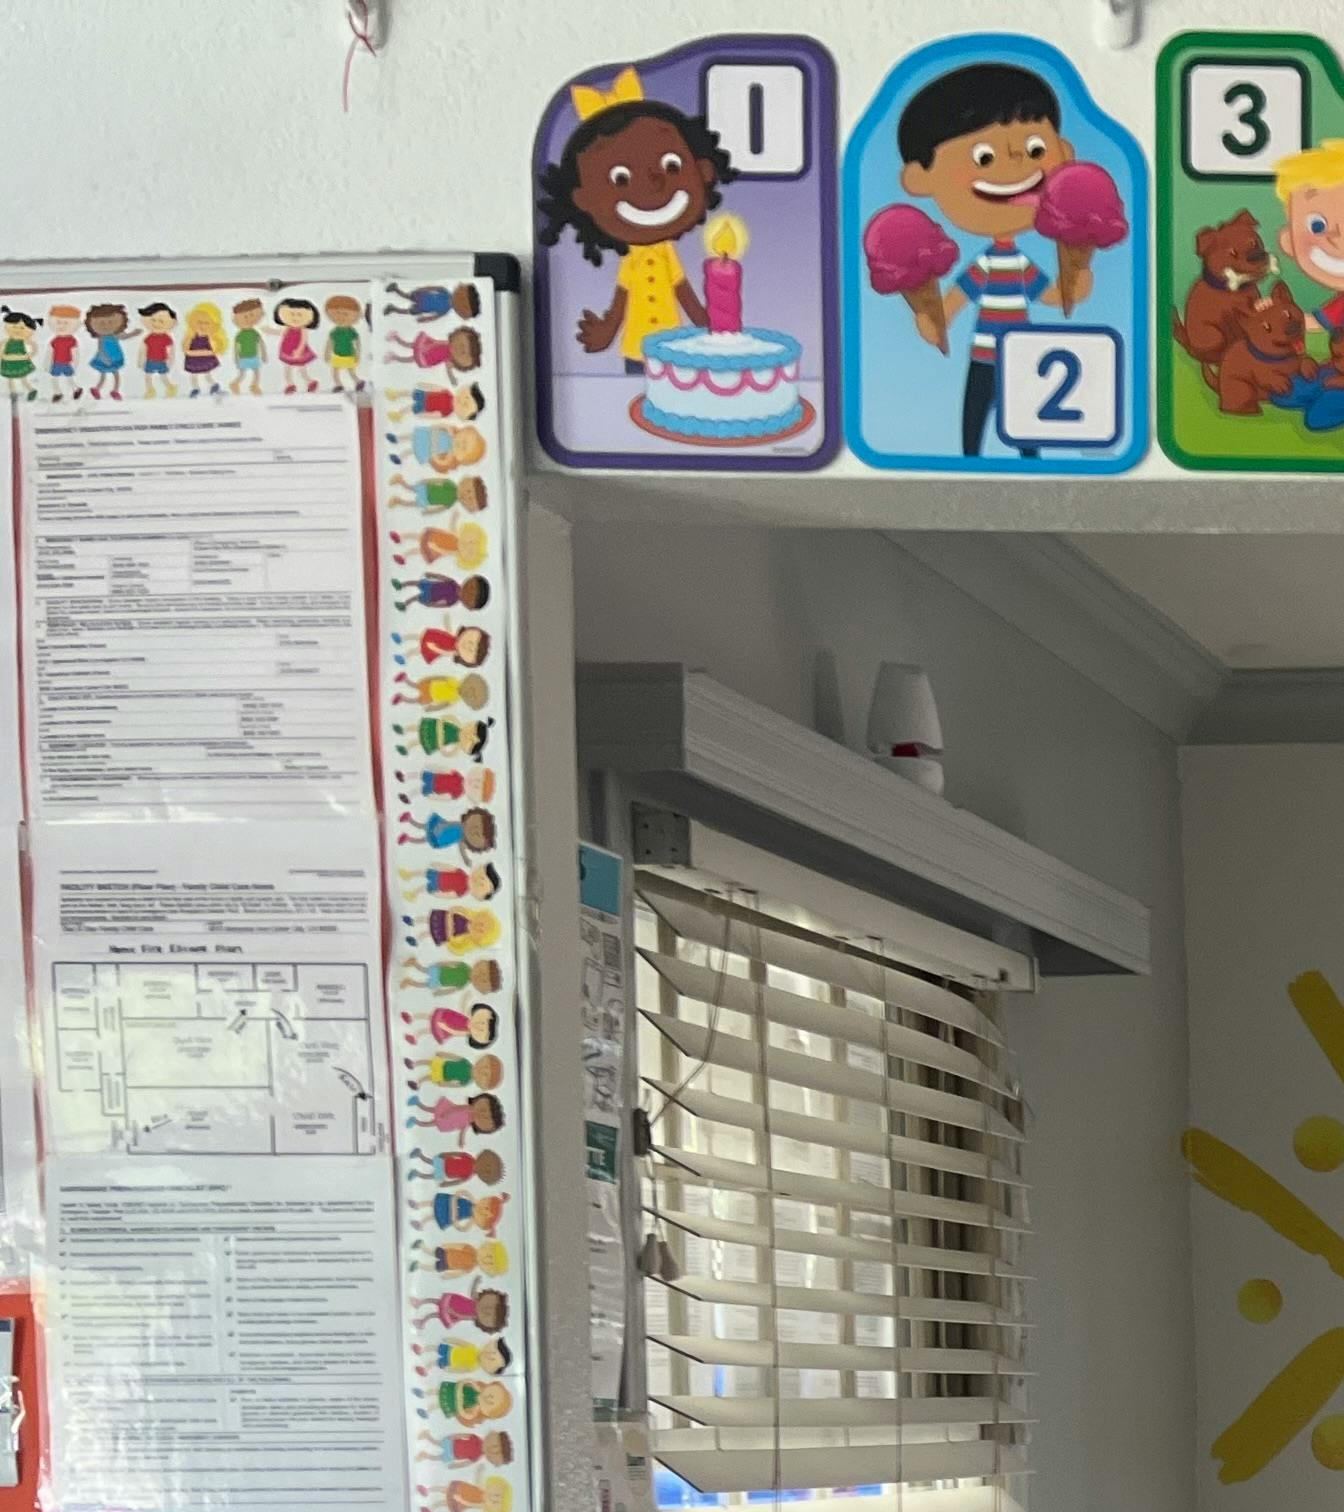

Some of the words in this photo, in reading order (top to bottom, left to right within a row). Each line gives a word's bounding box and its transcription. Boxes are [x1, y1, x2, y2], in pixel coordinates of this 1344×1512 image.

[747, 82, 765, 156] 1
[1221, 82, 1272, 157] 3
[1035, 348, 1085, 424] 2
